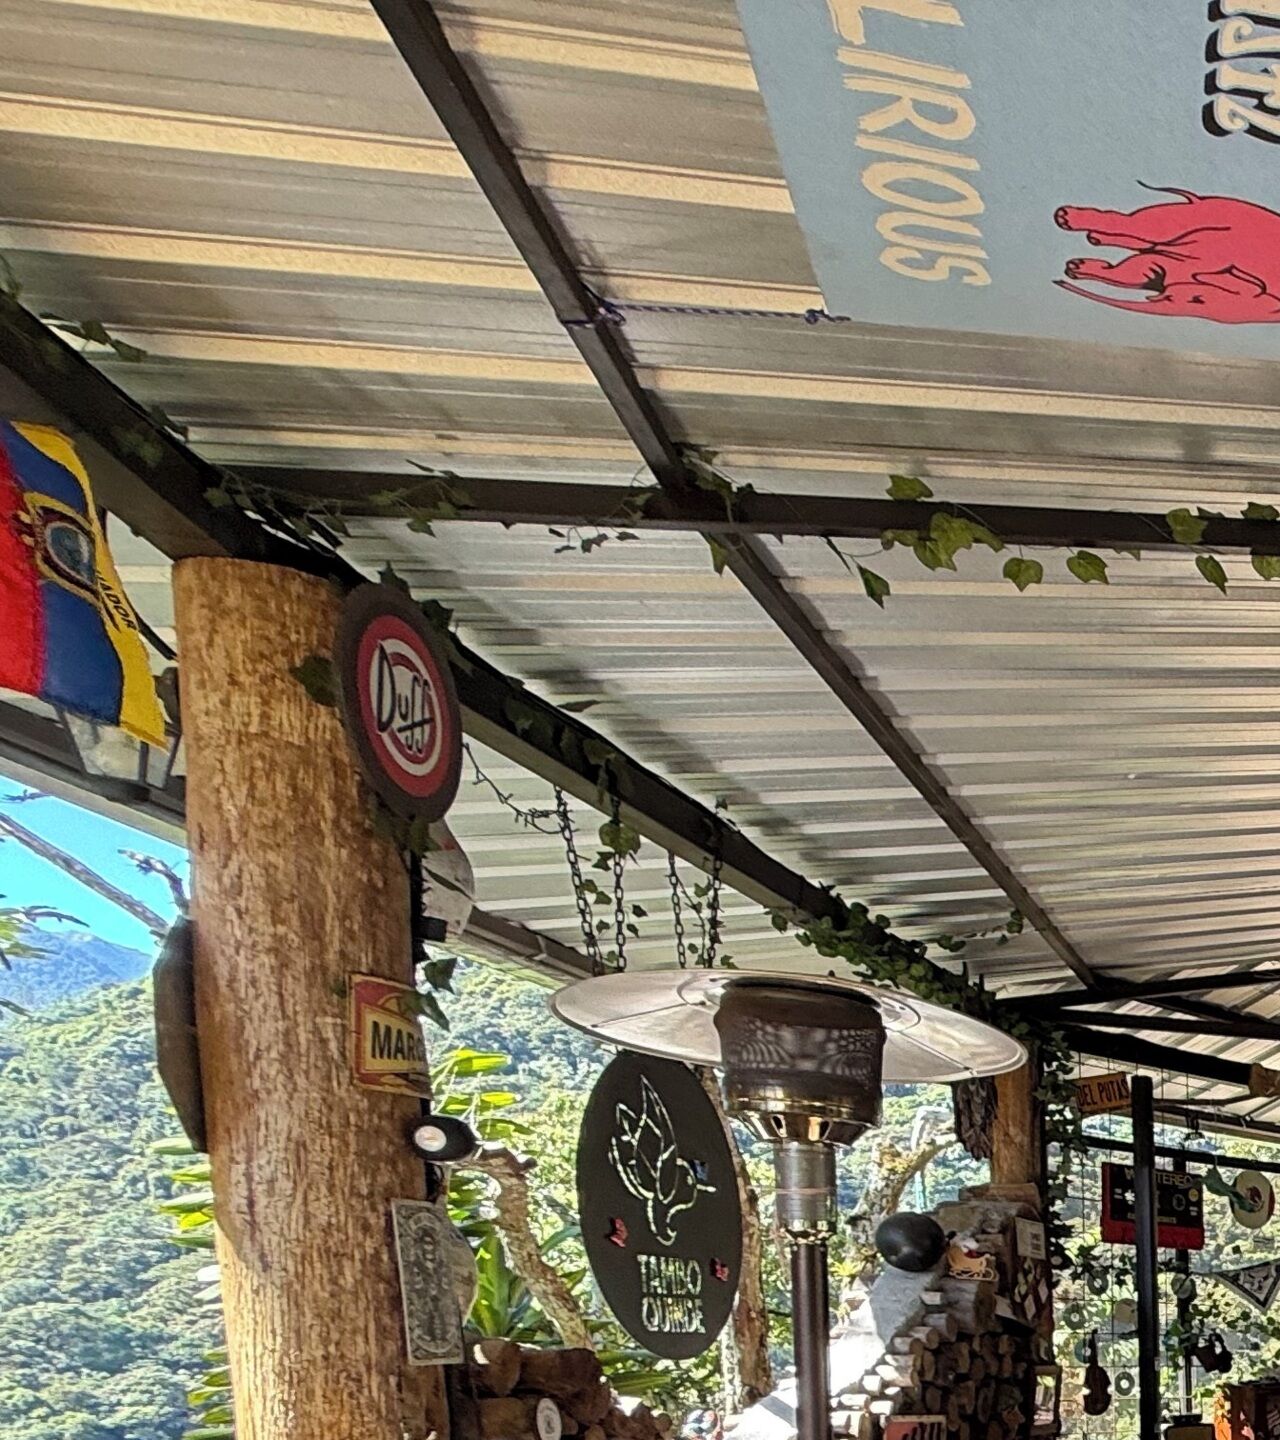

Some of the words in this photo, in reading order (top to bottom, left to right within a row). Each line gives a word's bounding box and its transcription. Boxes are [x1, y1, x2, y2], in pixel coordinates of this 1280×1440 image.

[98, 575, 138, 630] ADOR
[376, 642, 434, 754] Duff
[1097, 1078, 1130, 1103] PUTAS
[637, 1254, 702, 1294] TAMBO
